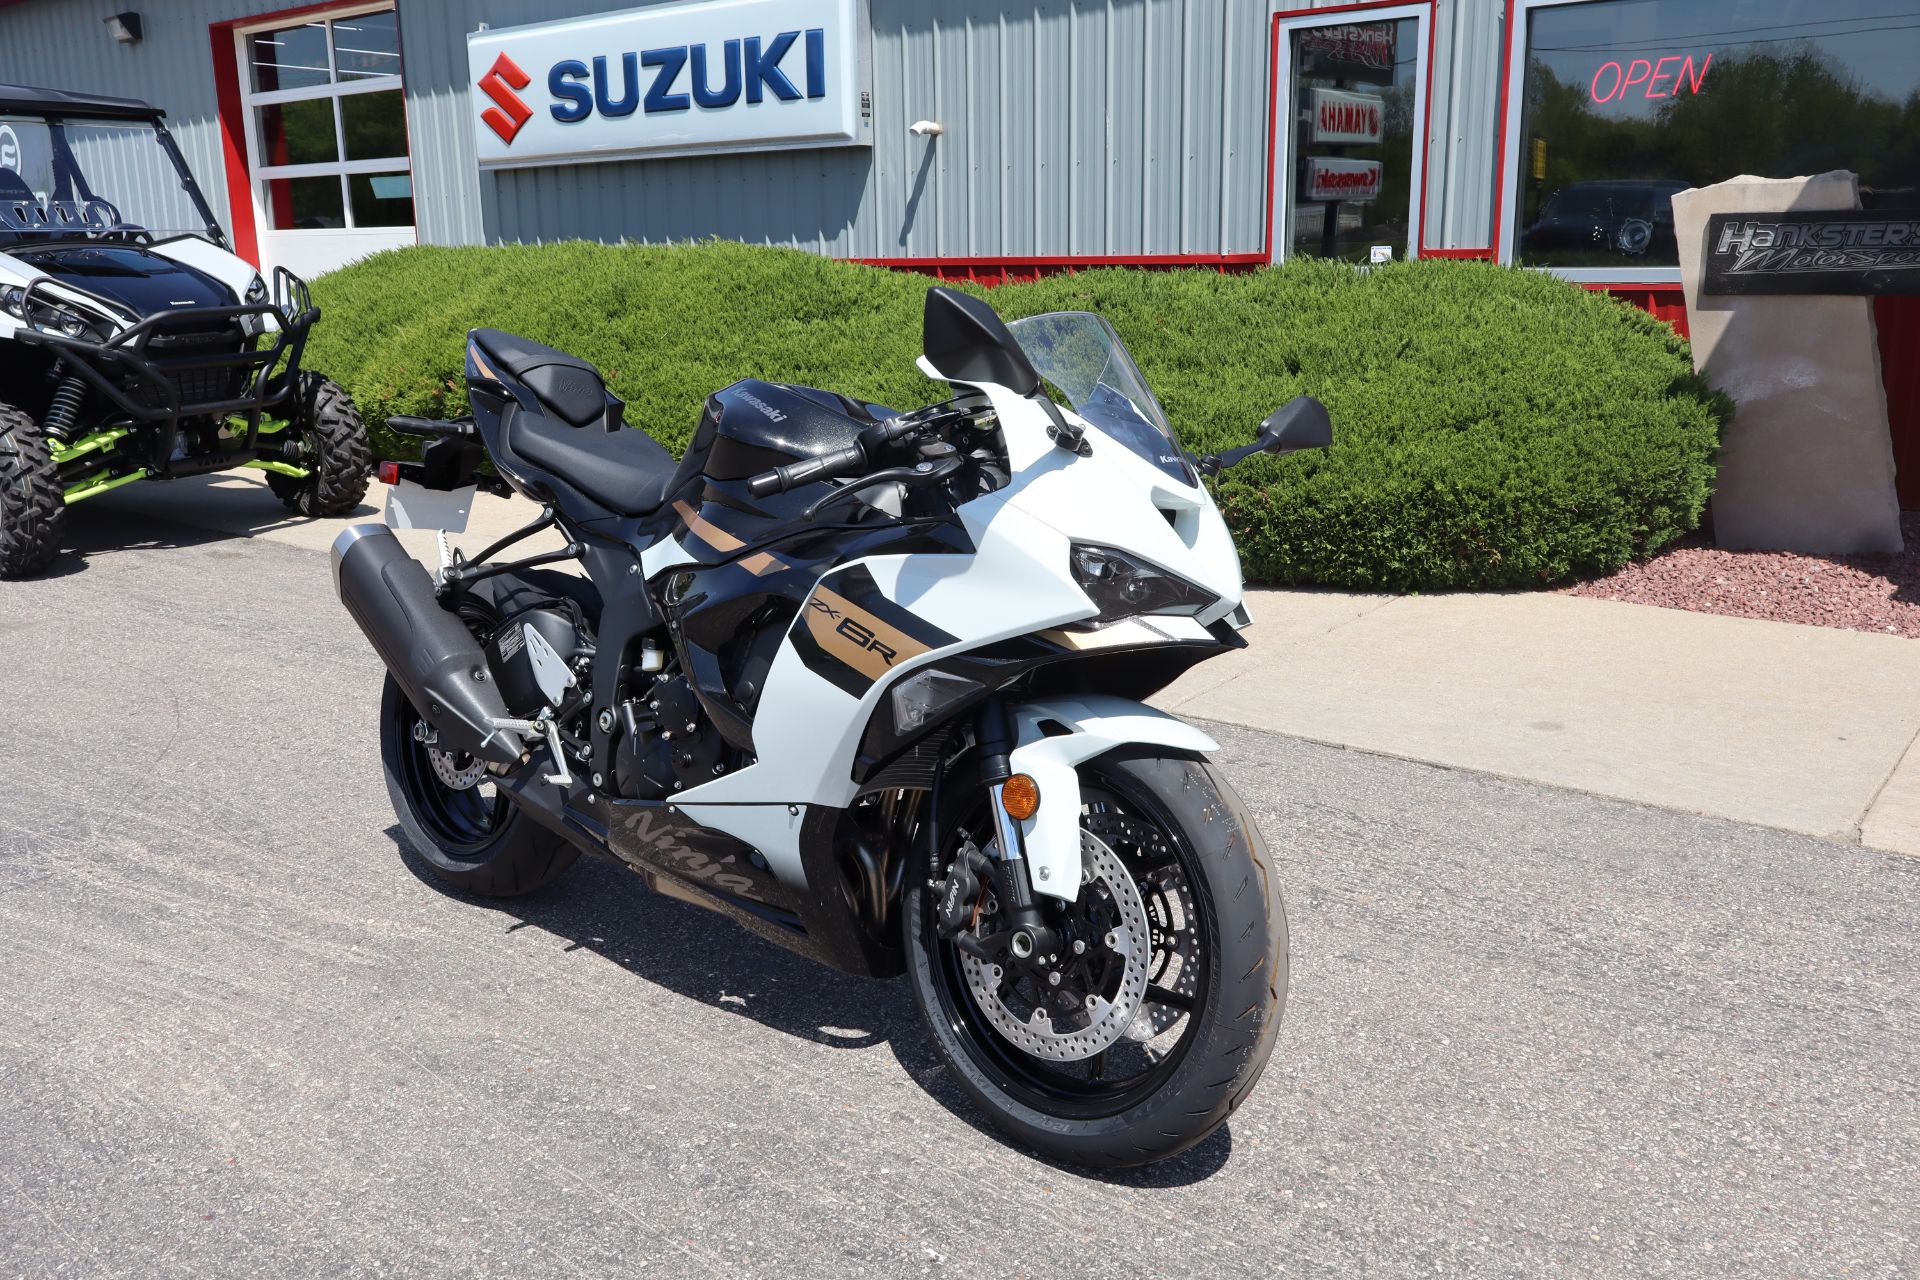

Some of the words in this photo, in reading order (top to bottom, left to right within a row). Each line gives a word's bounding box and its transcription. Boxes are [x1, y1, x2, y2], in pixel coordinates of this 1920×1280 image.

[548, 28, 825, 123] SUZUKI
[1591, 53, 1712, 104] OPEN
[731, 386, 788, 423] Kawasaki
[809, 597, 897, 667] ZX-6R
[625, 811, 764, 901] Ninja
